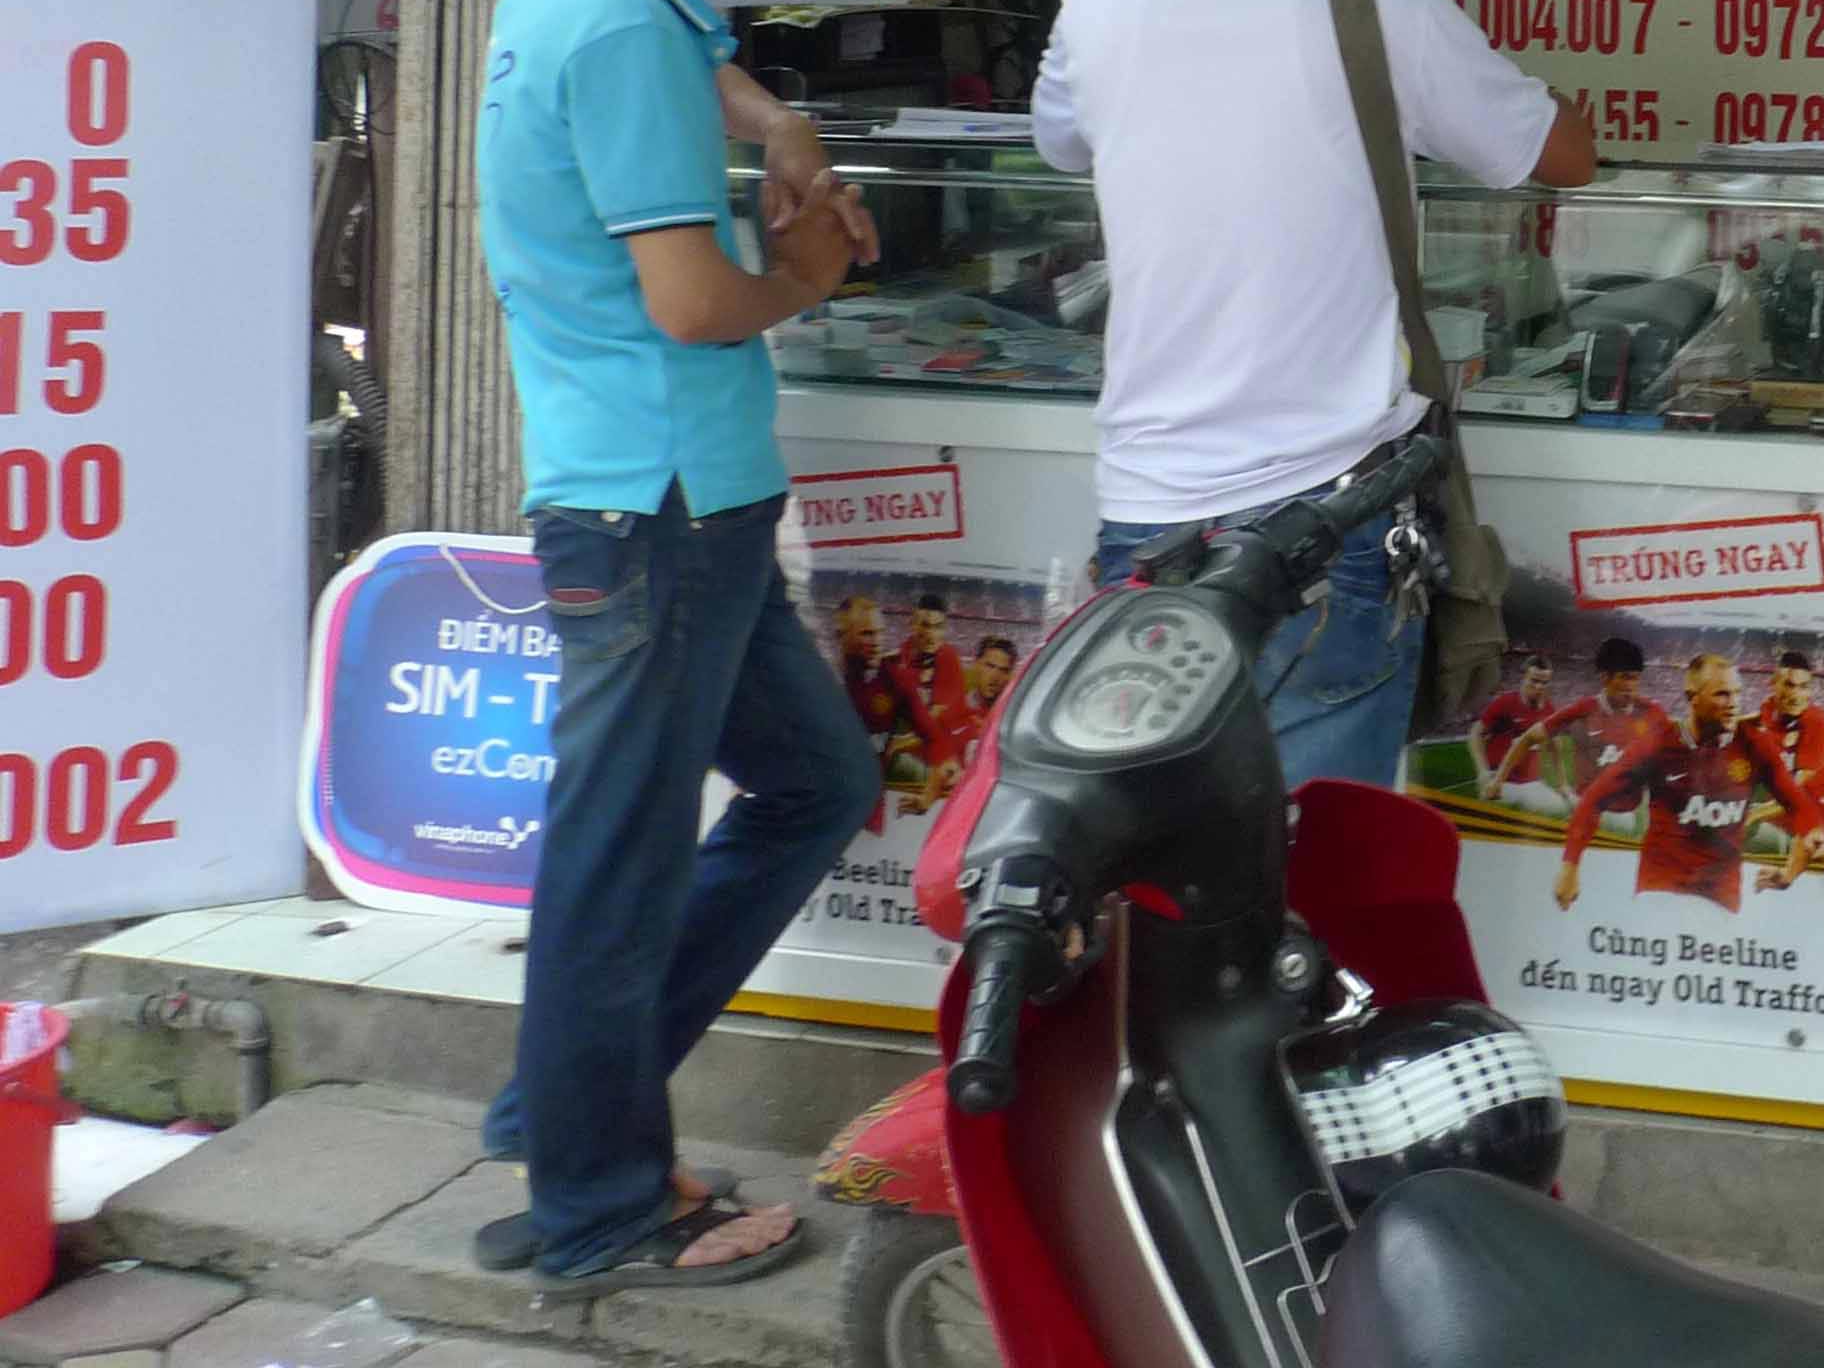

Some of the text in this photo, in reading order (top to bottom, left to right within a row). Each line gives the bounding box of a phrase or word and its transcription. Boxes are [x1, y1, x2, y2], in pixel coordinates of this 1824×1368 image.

[864, 490, 946, 523] NGAY
[1715, 540, 1809, 576] NGAY
[386, 662, 480, 719] SIM
[1588, 925, 1799, 971] Cùng Beeline
[1519, 959, 1577, 991] đến
[1586, 971, 1664, 1006] ngay
[1673, 974, 1726, 1005] Old
